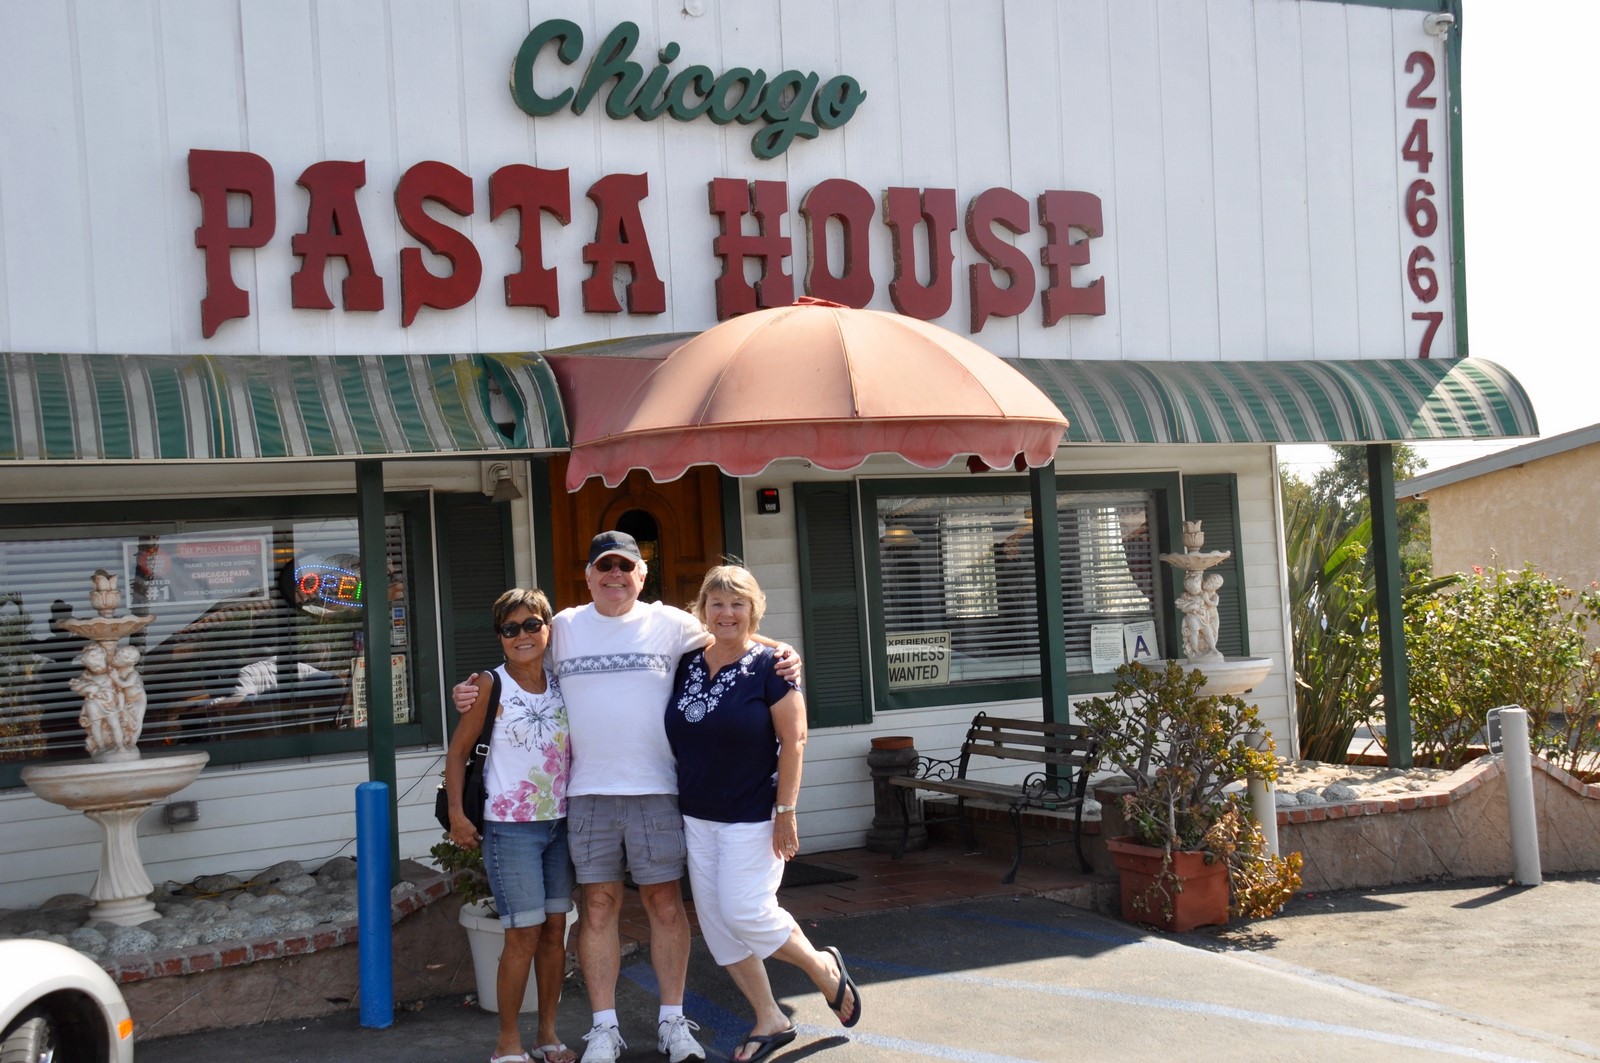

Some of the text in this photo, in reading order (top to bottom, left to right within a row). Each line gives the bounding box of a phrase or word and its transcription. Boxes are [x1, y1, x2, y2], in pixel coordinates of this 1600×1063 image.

[509, 19, 867, 160] Chicago
[1402, 51, 1443, 359] 24667
[188, 148, 1106, 338] PASTA HOUSE
[191, 569, 251, 579] CHICAGO PASTA
[208, 577, 234, 585] HOUSE
[147, 585, 170, 600] #1
[887, 636, 947, 646] XPERIENCED
[1134, 635, 1151, 658] A
[889, 664, 939, 682] WANTED
